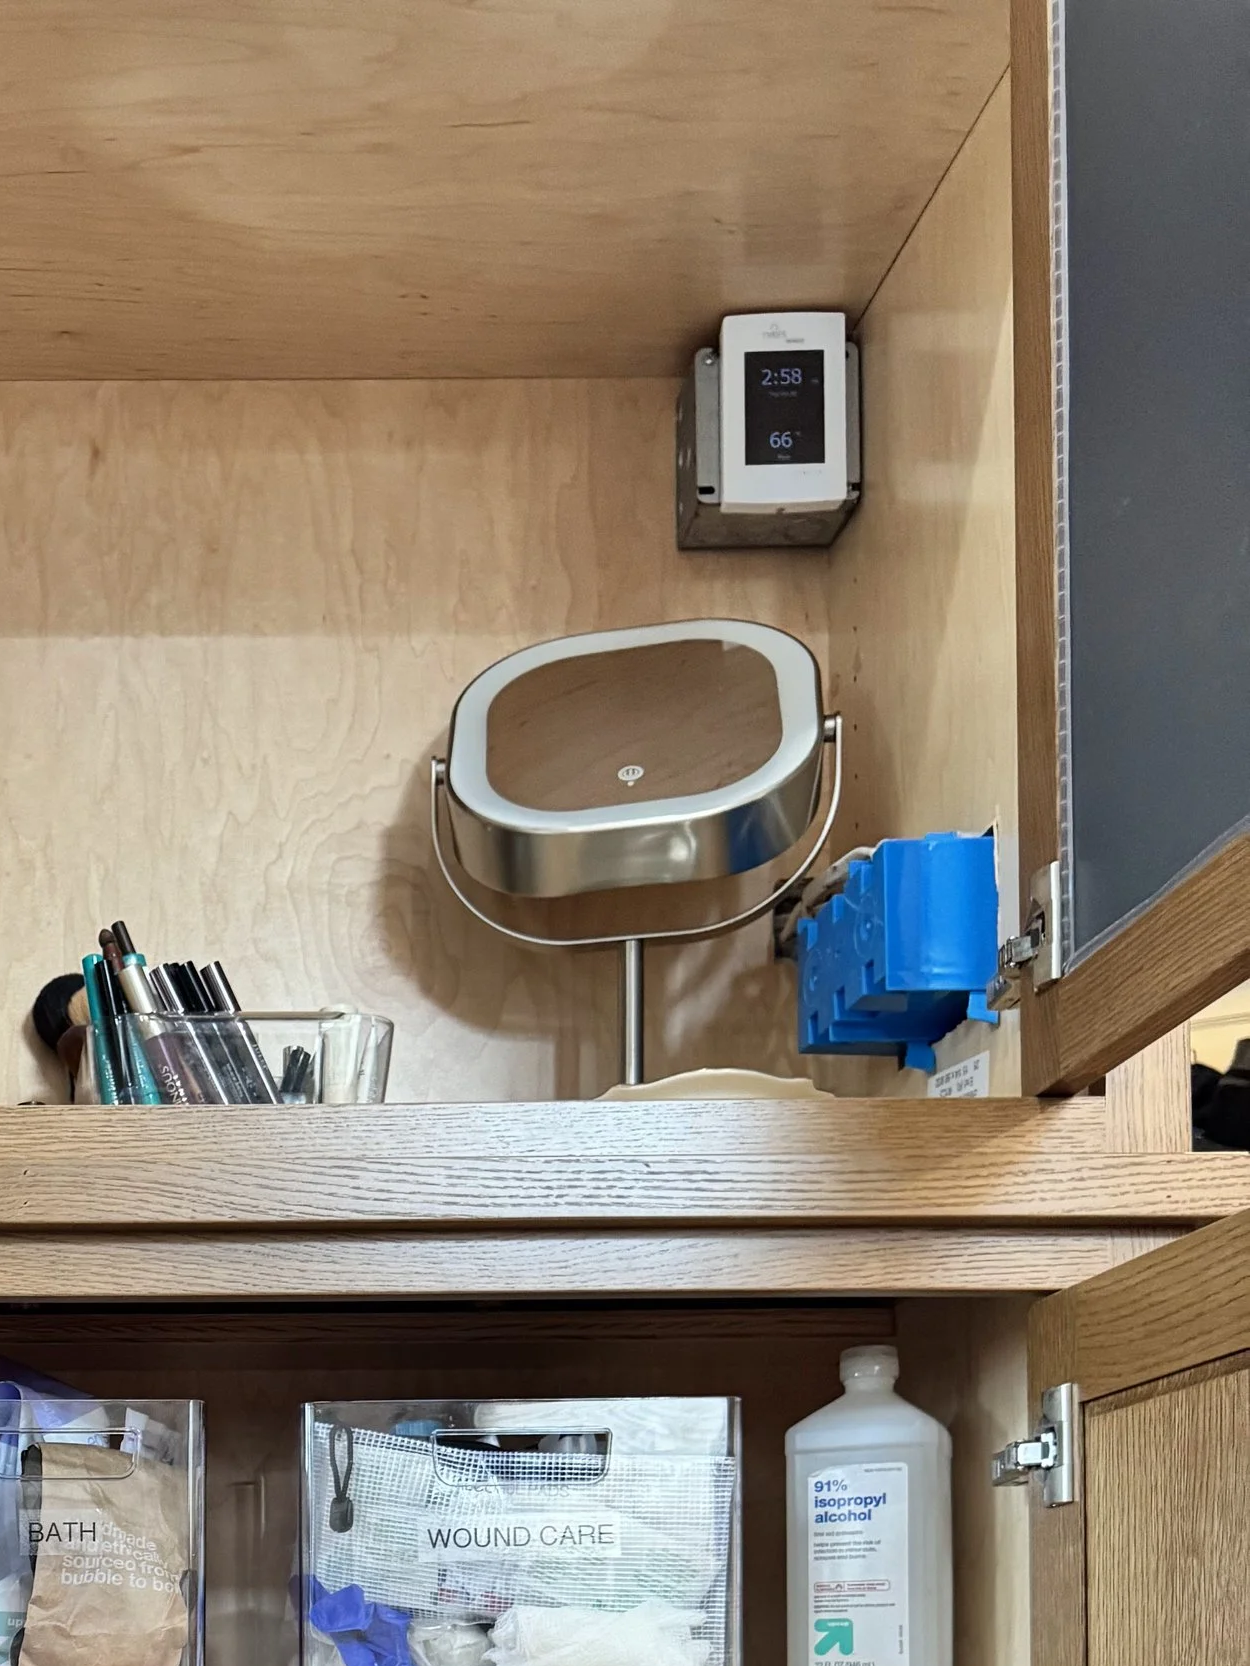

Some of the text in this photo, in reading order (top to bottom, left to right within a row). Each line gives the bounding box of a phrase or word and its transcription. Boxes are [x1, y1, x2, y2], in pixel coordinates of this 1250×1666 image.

[761, 367, 803, 386] 2:58
[769, 431, 793, 449] 66
[814, 1480, 848, 1493] 91%
[814, 1492, 887, 1509] isopropyl
[814, 1509, 872, 1523] alcohol
[29, 1522, 96, 1543] BATH
[427, 1524, 615, 1550] WOUND CARE
[61, 1568, 123, 1586] bubble
[128, 1574, 147, 1589] to
